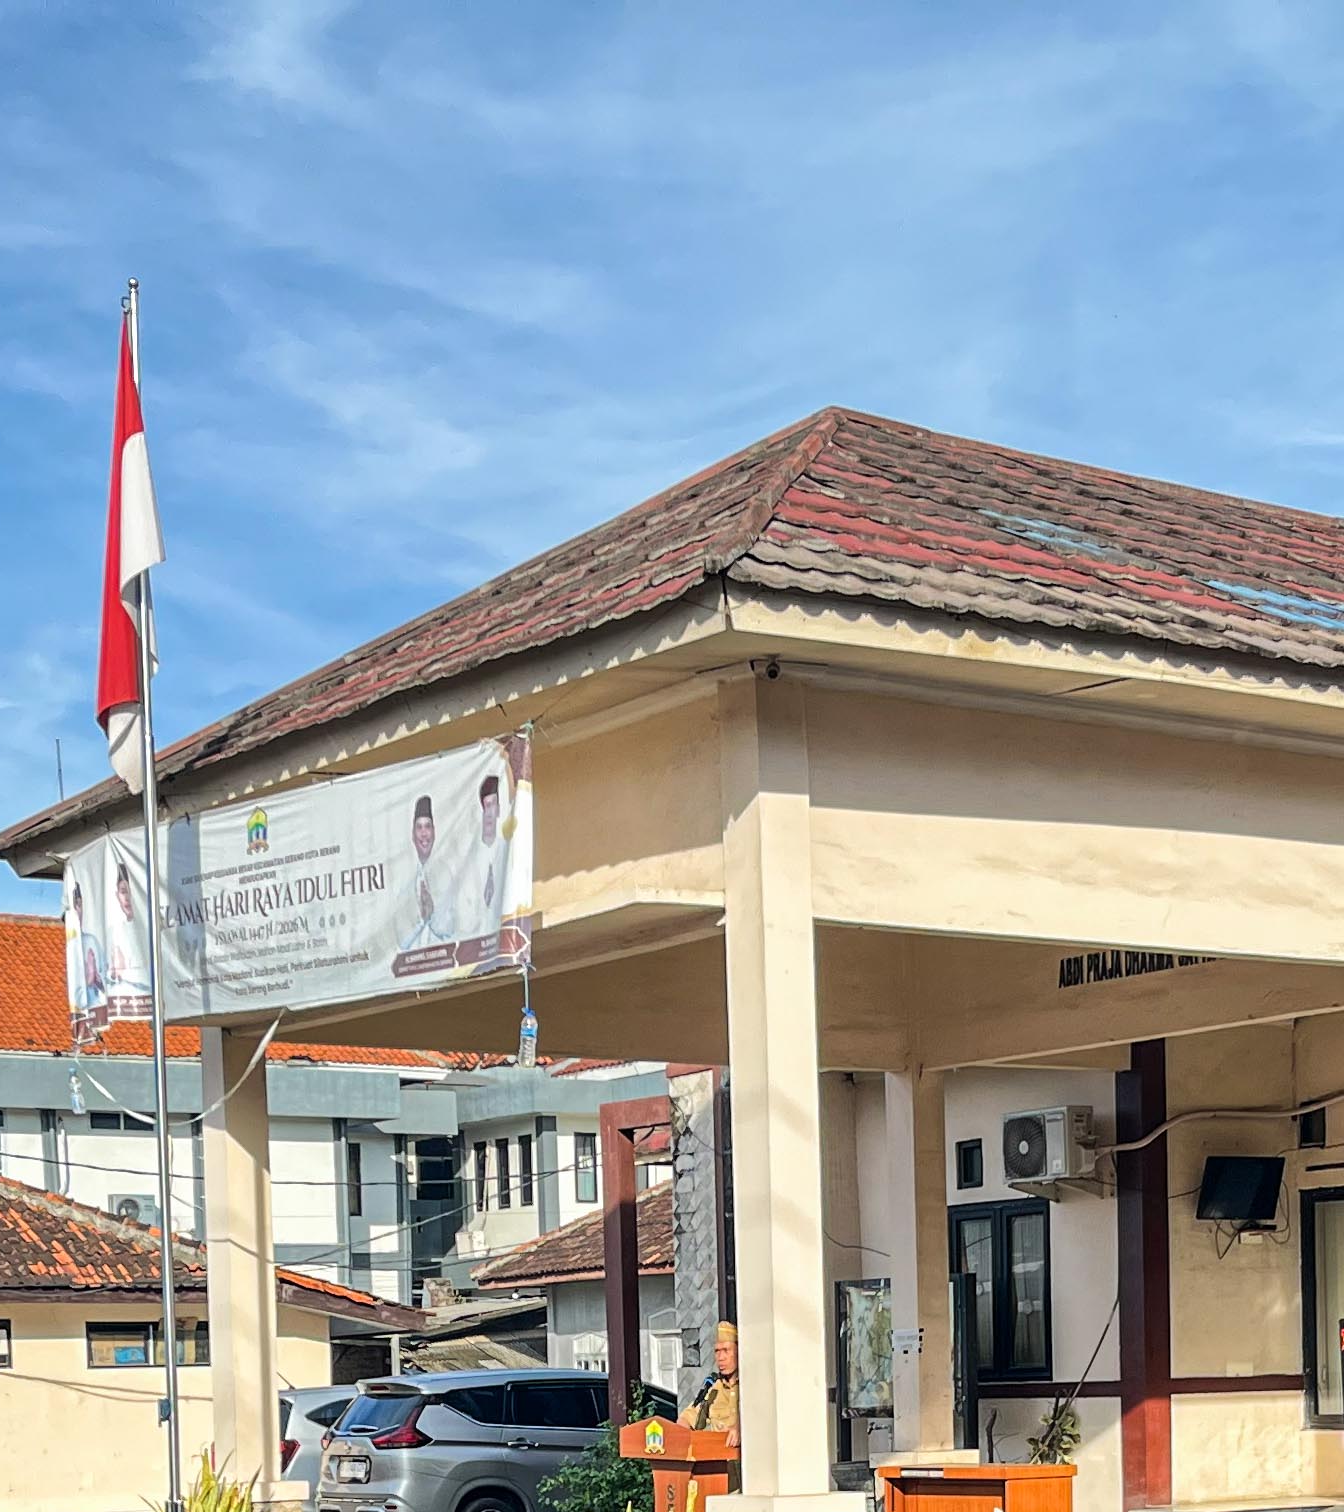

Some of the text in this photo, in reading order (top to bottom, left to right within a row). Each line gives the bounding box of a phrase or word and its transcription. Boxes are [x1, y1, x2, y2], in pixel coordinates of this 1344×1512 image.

[159, 863, 385, 928] LAMAT HARI RAYA IDUL FITRI
[1059, 956, 1083, 989] ABDI
[1087, 950, 1123, 983] PRAJA
